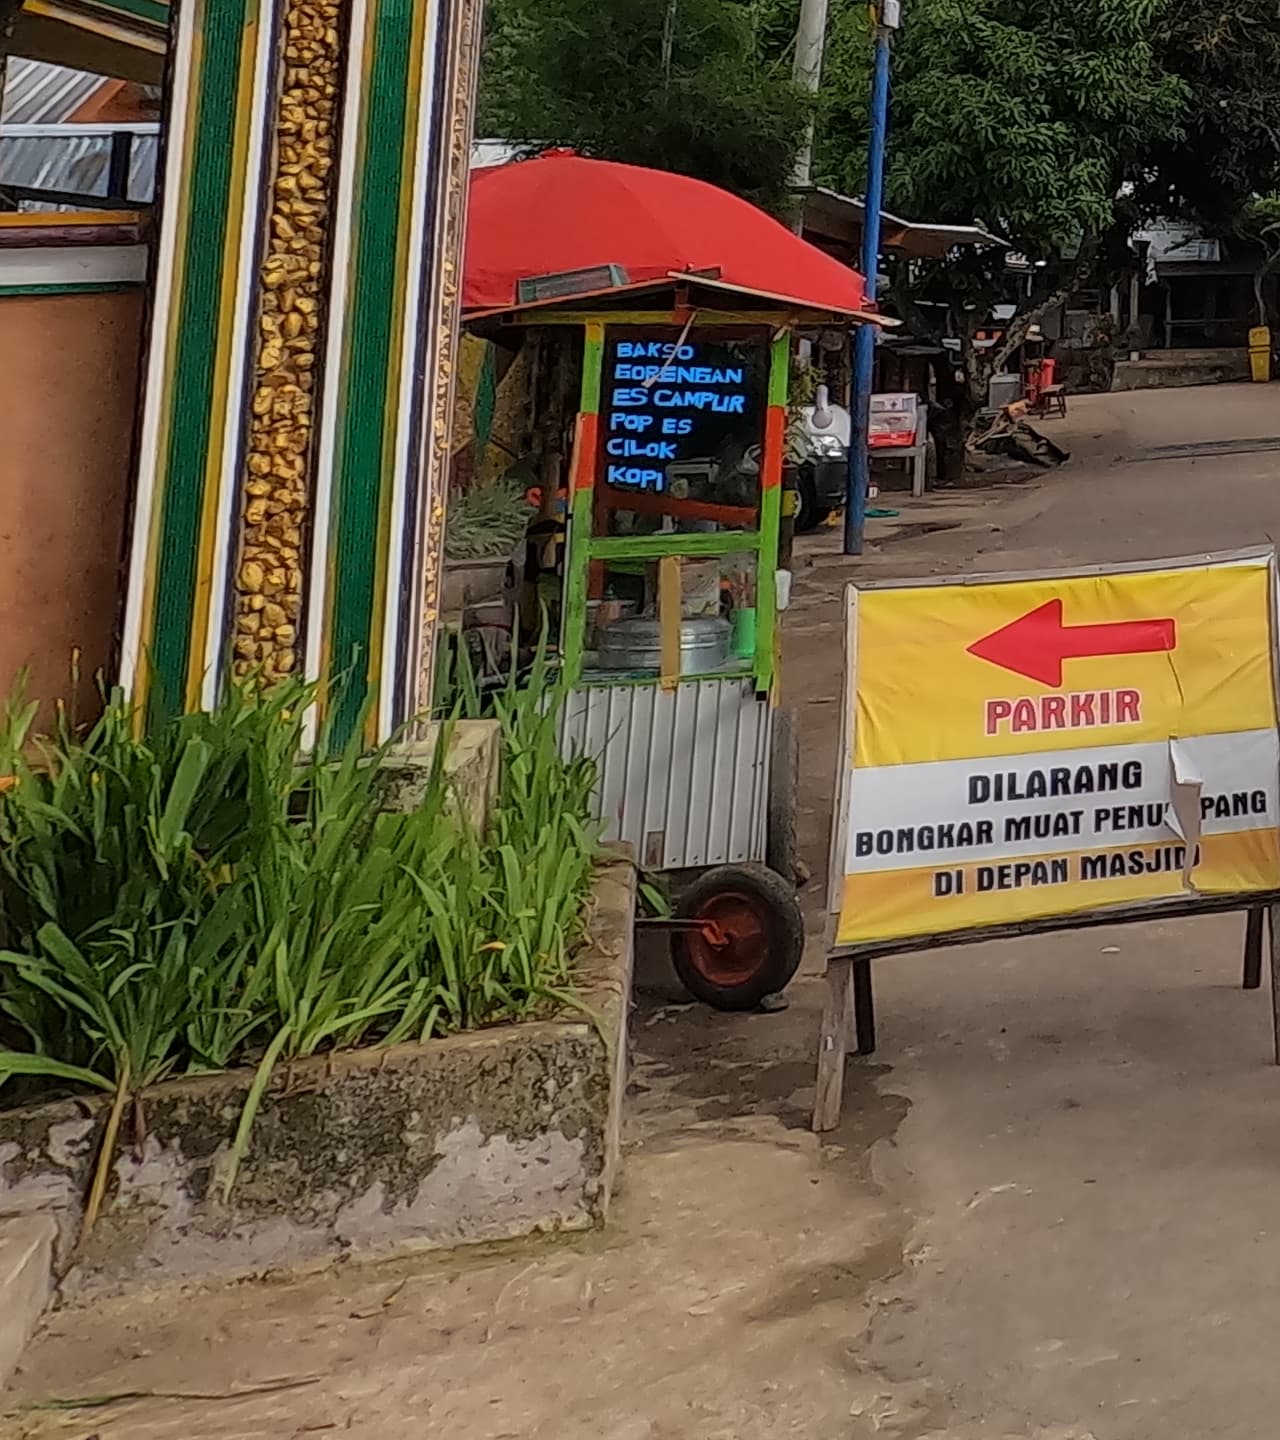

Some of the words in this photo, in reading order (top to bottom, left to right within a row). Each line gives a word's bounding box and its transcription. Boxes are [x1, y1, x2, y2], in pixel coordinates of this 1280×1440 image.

[616, 342, 694, 360] BAKSO
[614, 364, 742, 384] GORENGAN
[612, 388, 649, 407] ES
[653, 389, 745, 413] CAMPUR
[610, 412, 653, 433] POP
[661, 418, 693, 434] ES
[607, 464, 664, 492] KOPI
[984, 689, 1142, 737] PARKIR
[968, 760, 1143, 805] DILARANG
[855, 823, 994, 858] BONGKAR
[1003, 811, 1083, 842] MUAT
[1093, 790, 1267, 833] PENUPANG
[933, 872, 964, 898] DI
[976, 859, 1069, 891] DEPAN
[1080, 844, 1200, 882] MASJID
